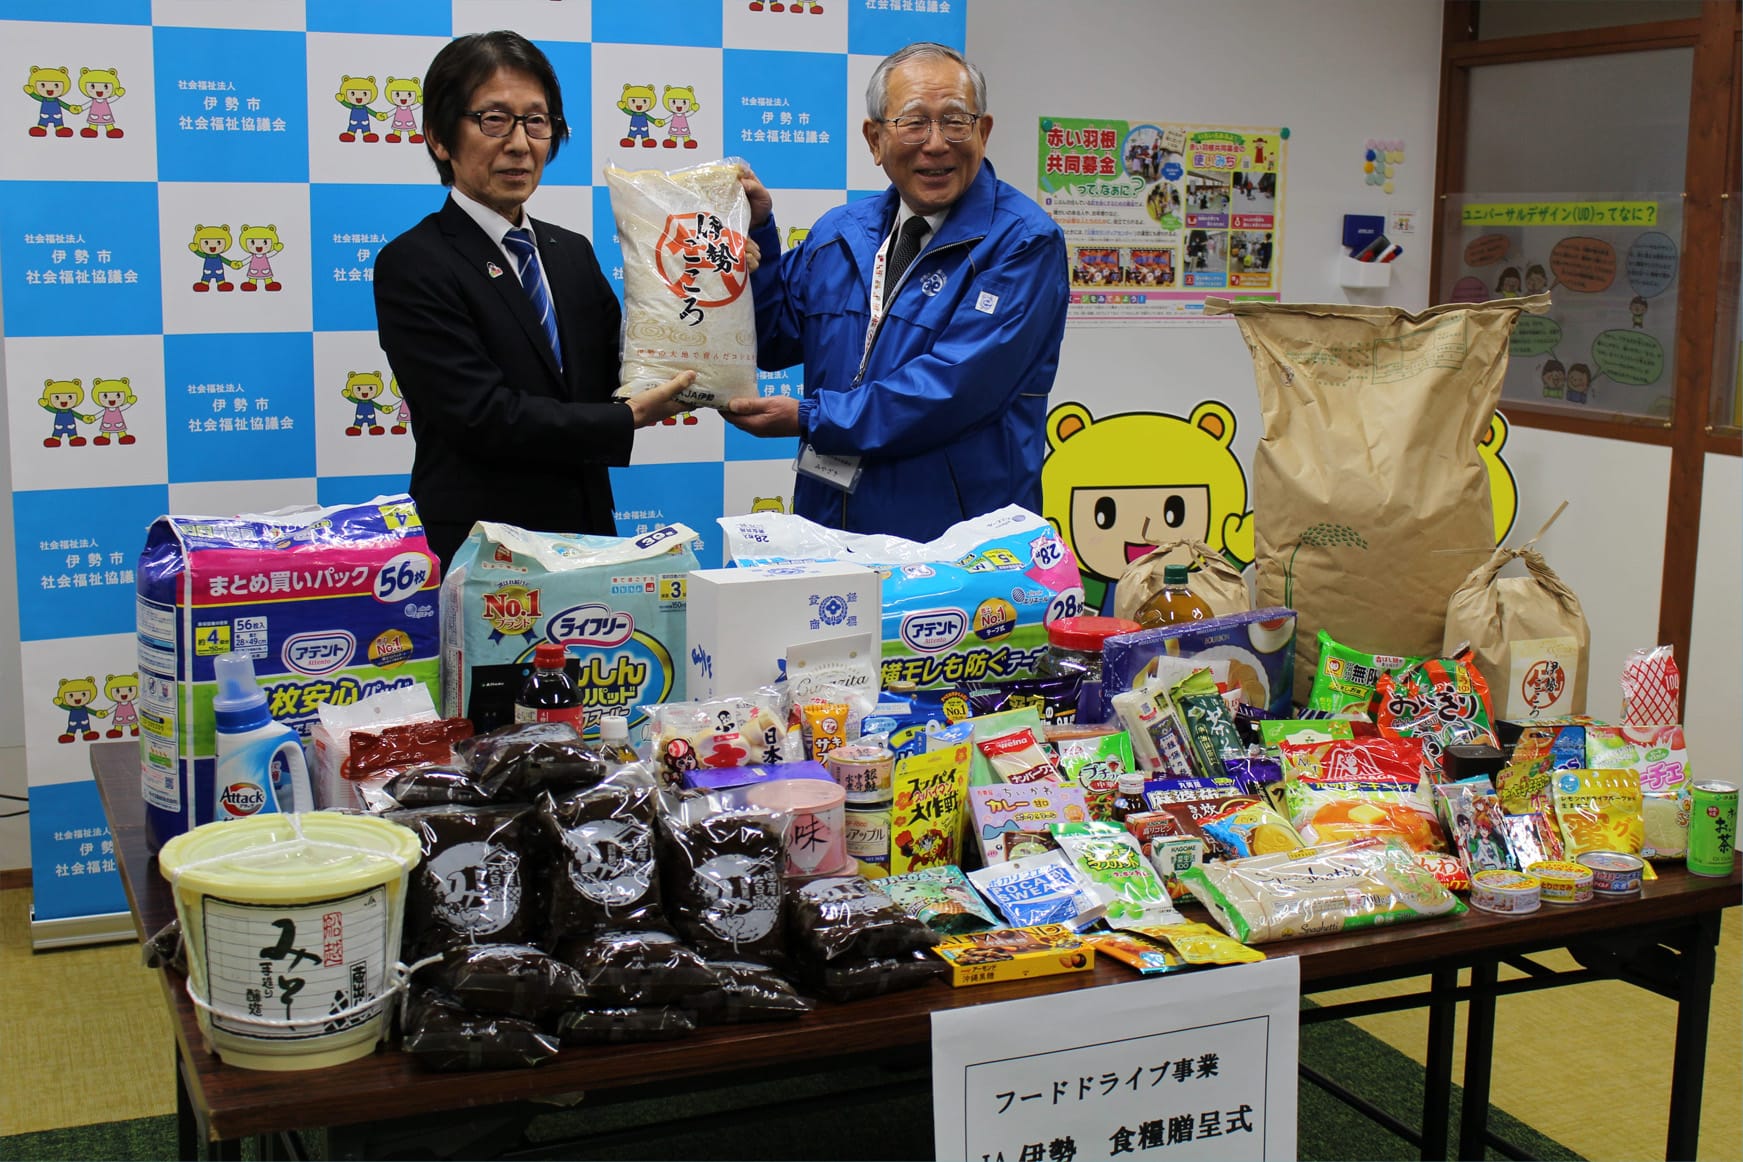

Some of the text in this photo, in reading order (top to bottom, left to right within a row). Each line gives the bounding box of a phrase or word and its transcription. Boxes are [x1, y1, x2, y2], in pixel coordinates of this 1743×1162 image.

[177, 80, 236, 91] 社会福祉法人
[203, 96, 262, 111] 伊勢市
[741, 97, 790, 107] 社会福祉法人
[178, 116, 287, 132] 社会福祉協議会
[762, 113, 810, 125] 伊勢市
[741, 129, 830, 144] 社会福祉協議会
[1047, 128, 1117, 149] 赤い羽根
[1046, 154, 1116, 175] 共同募金
[24, 234, 86, 245] 社会福祉法人
[51, 249, 112, 265] 伊勢市
[26, 269, 139, 285] 社会福祉協議会
[187, 384, 244, 394] 社会福祉法人
[213, 397, 269, 412] 伊勢市
[188, 416, 294, 432] 社会福祉協議会
[615, 511, 664, 520] 社会福祉法人
[40, 540, 98, 551] 社会福祉法人
[66, 552, 124, 568] 伊勢市
[208, 565, 369, 597] まとめ買いパック
[379, 561, 426, 598] 56枚
[483, 588, 542, 619] No.1
[559, 616, 627, 638] ライフリー
[911, 620, 958, 639] アテント
[295, 643, 344, 661] アテント
[946, 705, 967, 717] No.1
[220, 786, 264, 804] Attack
[985, 798, 1030, 814] カレー
[54, 827, 112, 840] 社会福祉法人
[260, 918, 323, 1031] みそ
[996, 1053, 1220, 1114] フードドライブ事業
[1109, 1104, 1253, 1156] 食糧贈呈式
